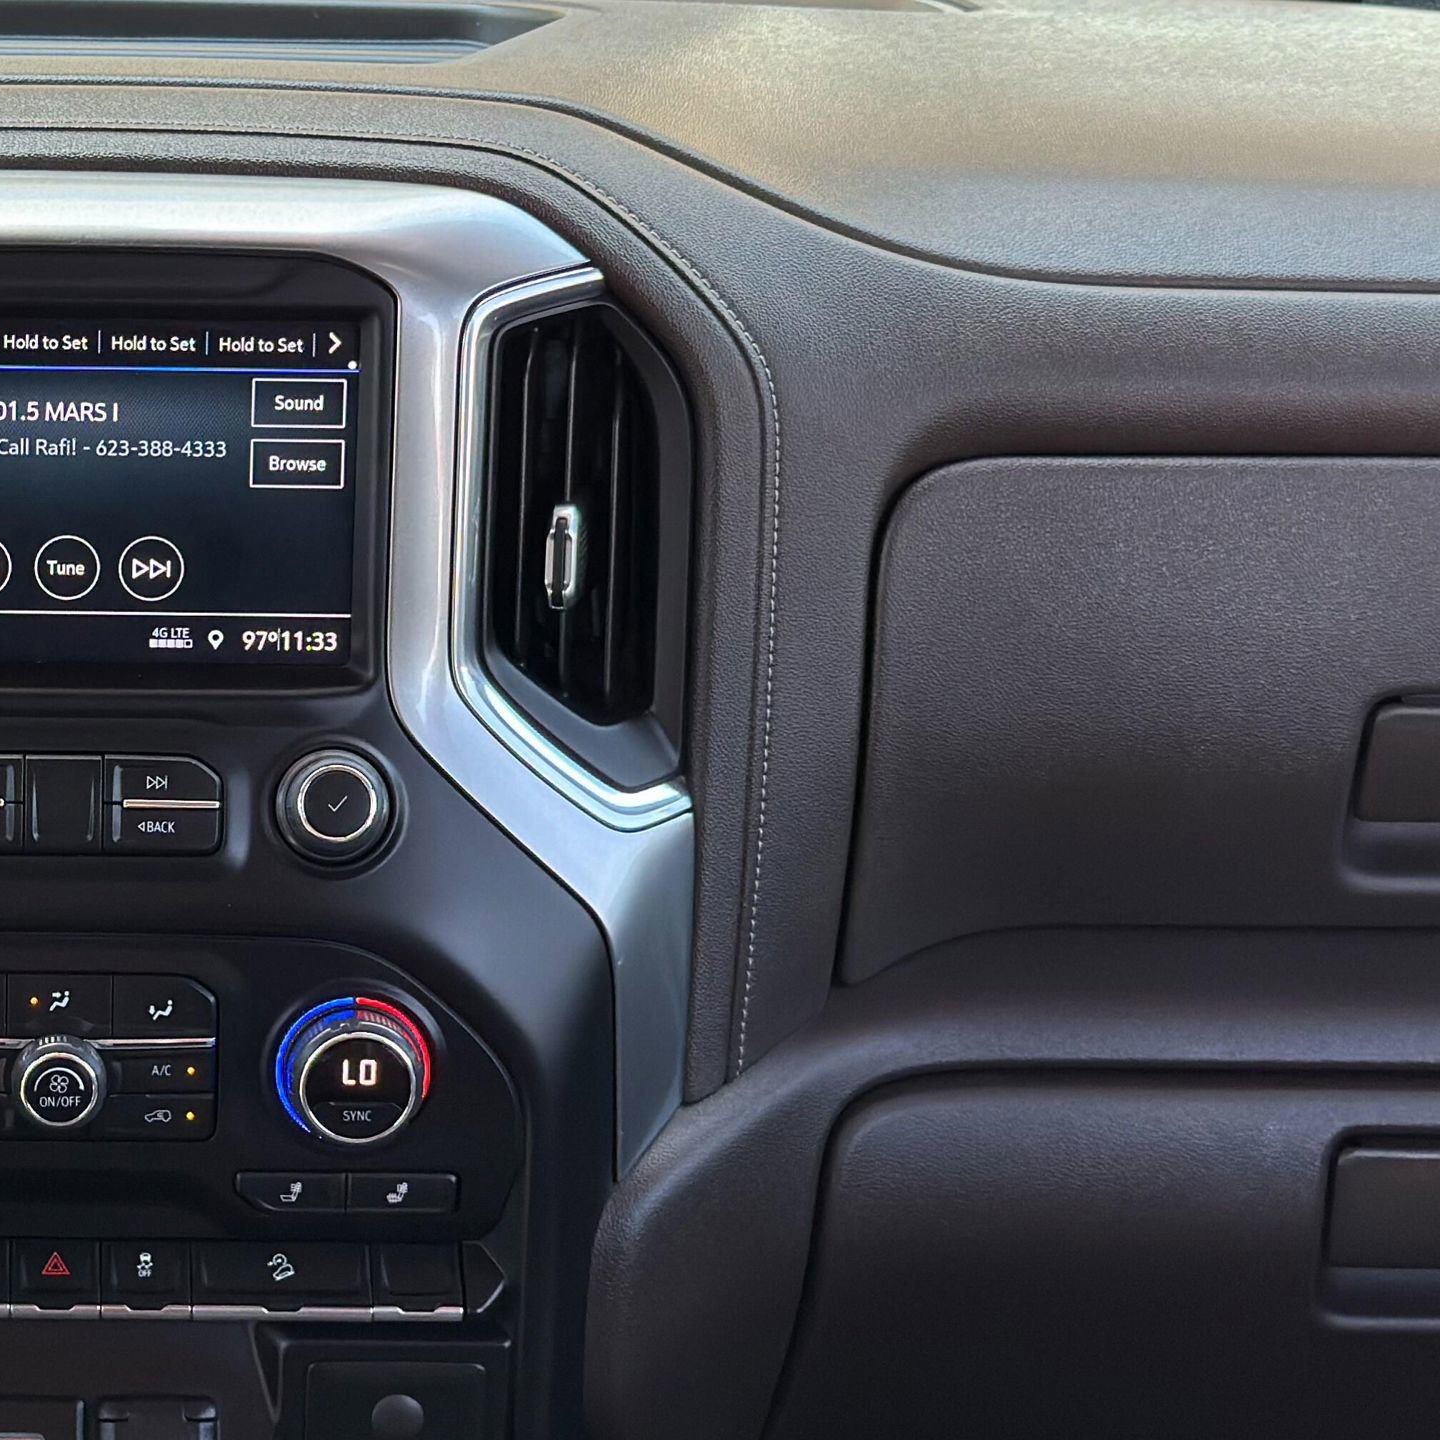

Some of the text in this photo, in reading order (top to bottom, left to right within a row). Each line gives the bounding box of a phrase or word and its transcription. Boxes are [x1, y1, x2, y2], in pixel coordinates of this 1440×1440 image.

[3, 333, 89, 351] Hold to Set
[111, 335, 196, 352] Hold to Set
[219, 336, 304, 353] Hold to Set
[274, 394, 325, 411] Sound
[44, 400, 108, 422] MARS
[111, 402, 119, 423] I
[35, 437, 76, 456] Rafi!
[95, 439, 227, 458] 623-388-4333
[269, 455, 327, 473] Browse
[46, 560, 85, 577] Tune
[151, 627, 190, 639] 4G LTE
[281, 631, 338, 653] 11:33
[146, 819, 176, 835] BACK
[151, 1063, 172, 1077] A/C
[342, 1058, 378, 1086] LO
[38, 1094, 82, 1109] ON/OFF
[342, 1109, 372, 1123] SYNC
[137, 1268, 152, 1279] OFF
